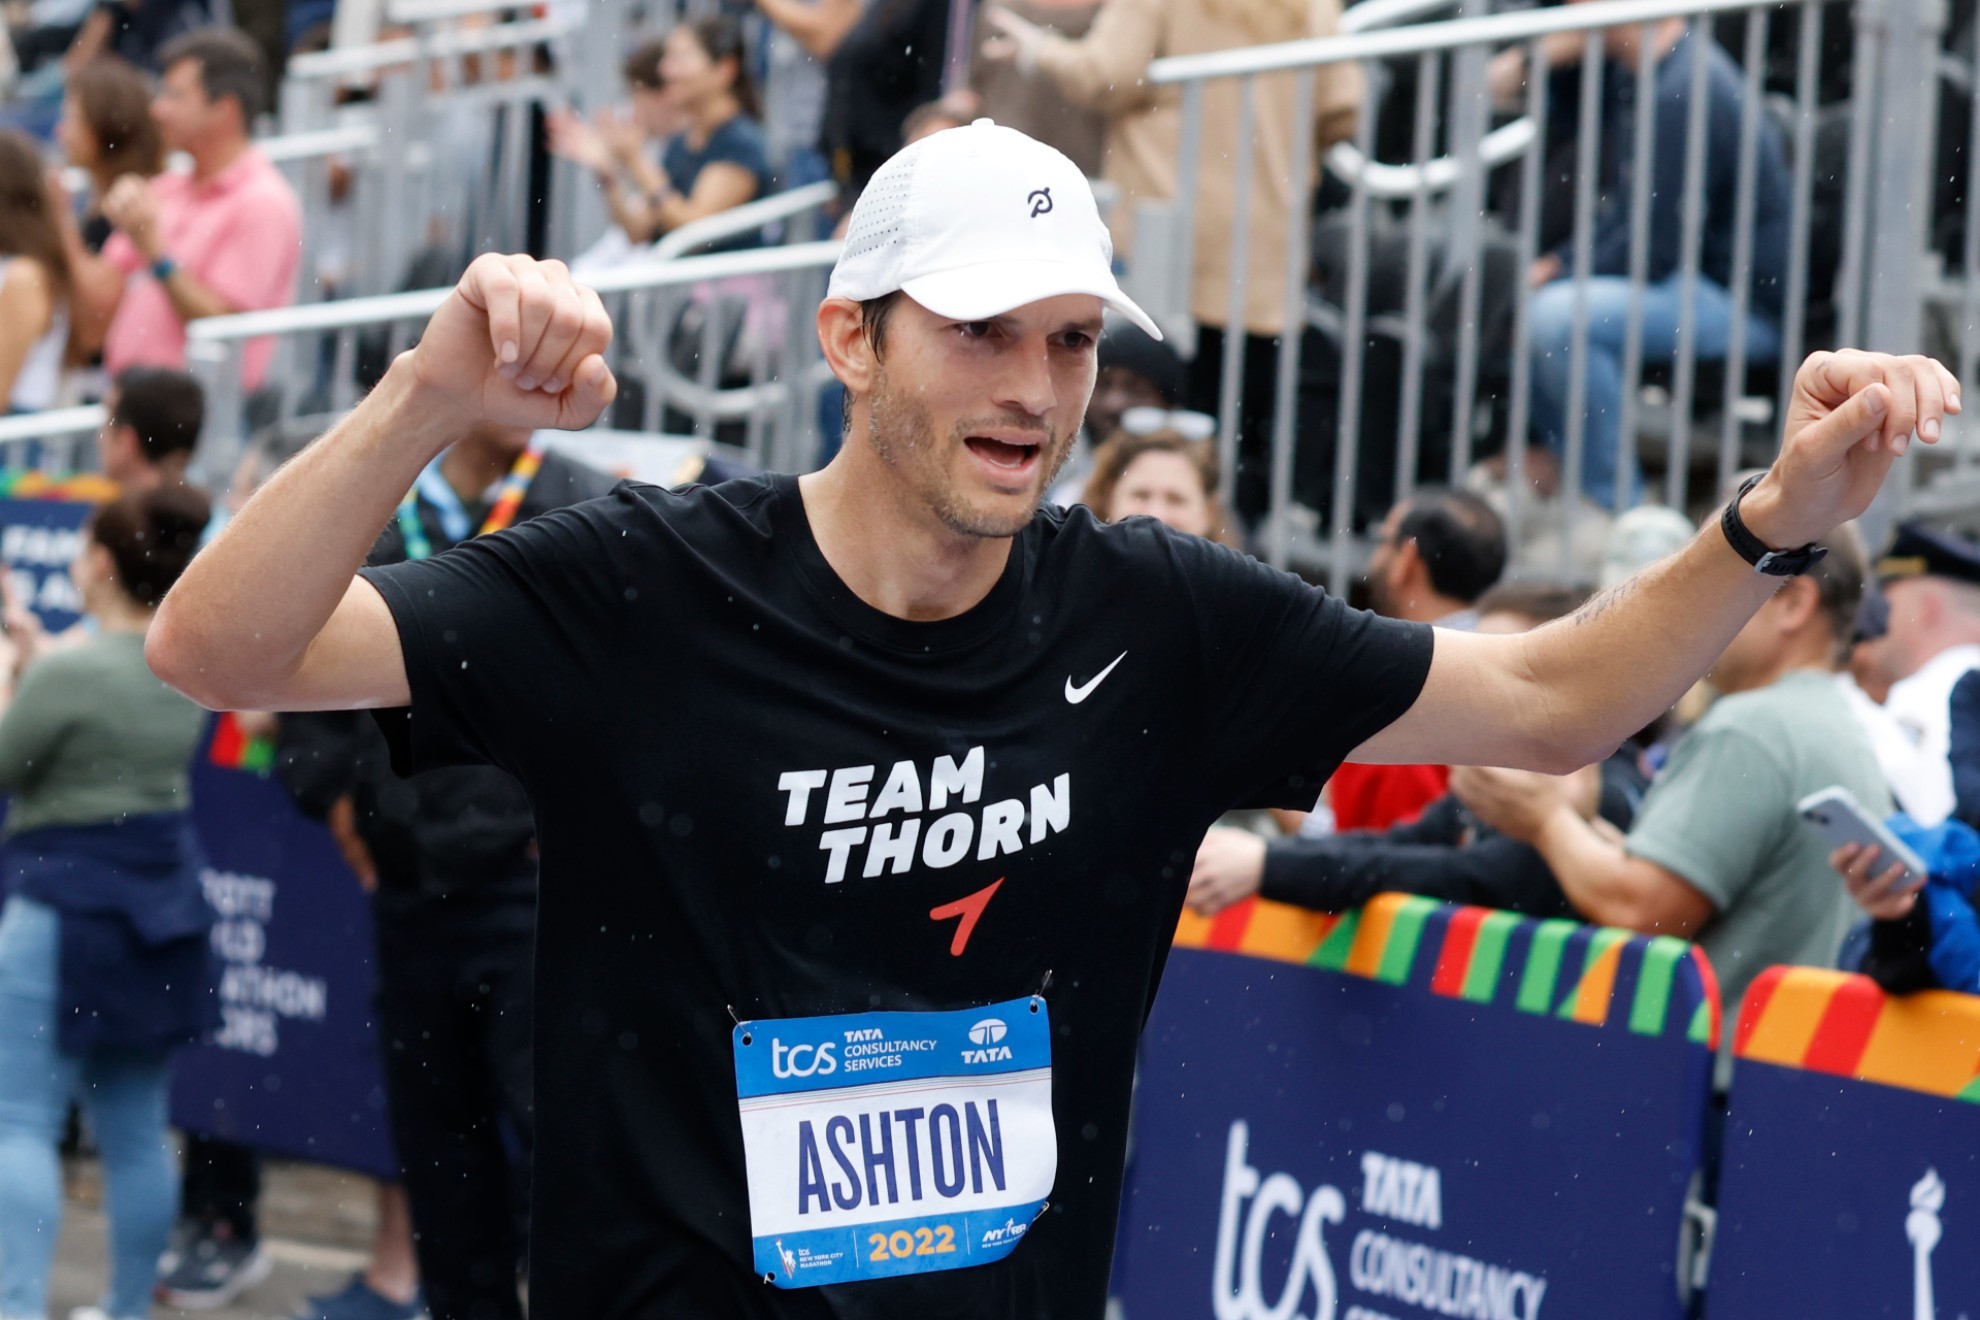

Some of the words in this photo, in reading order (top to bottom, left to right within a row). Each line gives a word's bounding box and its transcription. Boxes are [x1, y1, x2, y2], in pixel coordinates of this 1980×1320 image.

[777, 745, 985, 826] TEAM
[818, 771, 1070, 884] THORN
[844, 1029, 883, 1042] TATA
[844, 1040, 938, 1057] CONSULTANCY
[961, 1046, 1013, 1064] TATA
[771, 1037, 837, 1079] tcs
[844, 1055, 902, 1072] SERVICES
[798, 1098, 1007, 1215] ASHTON
[1361, 1151, 1443, 1231] TATA
[1212, 1119, 1346, 1320] tcs
[800, 1260, 832, 1268] MARATHON
[868, 1224, 956, 1262] 2022
[1351, 1228, 1547, 1320] CONSULTANCY
